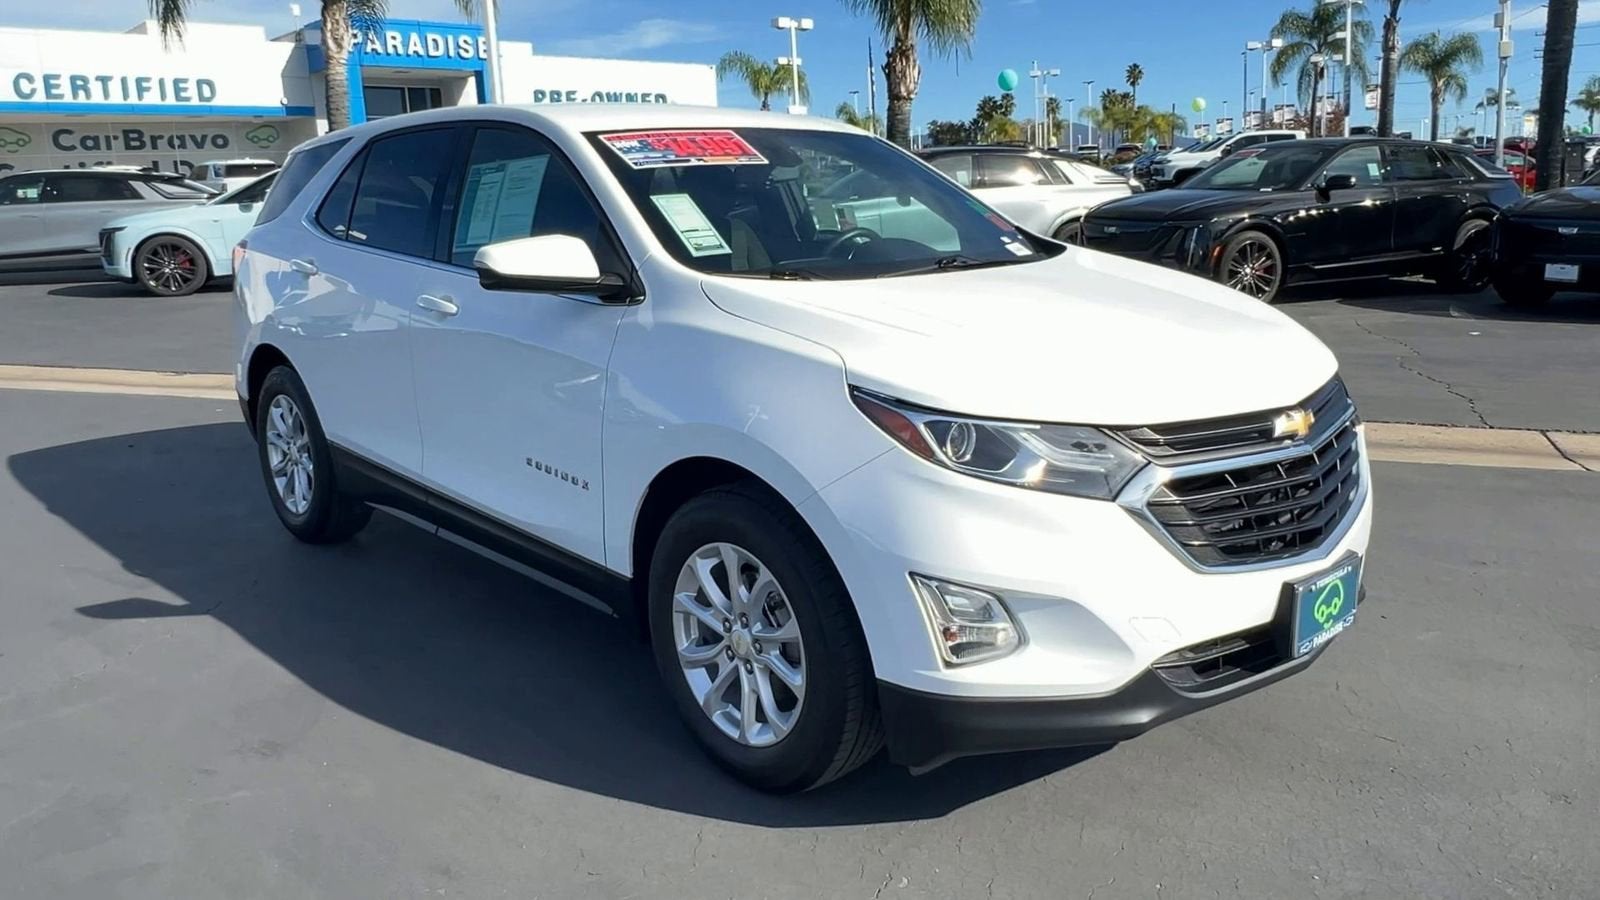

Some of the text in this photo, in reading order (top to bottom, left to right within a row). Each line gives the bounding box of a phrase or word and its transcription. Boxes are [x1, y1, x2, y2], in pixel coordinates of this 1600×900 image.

[348, 29, 488, 59] PARADISE
[13, 72, 217, 102] CERTIFIED
[52, 128, 230, 151] CarBravo
